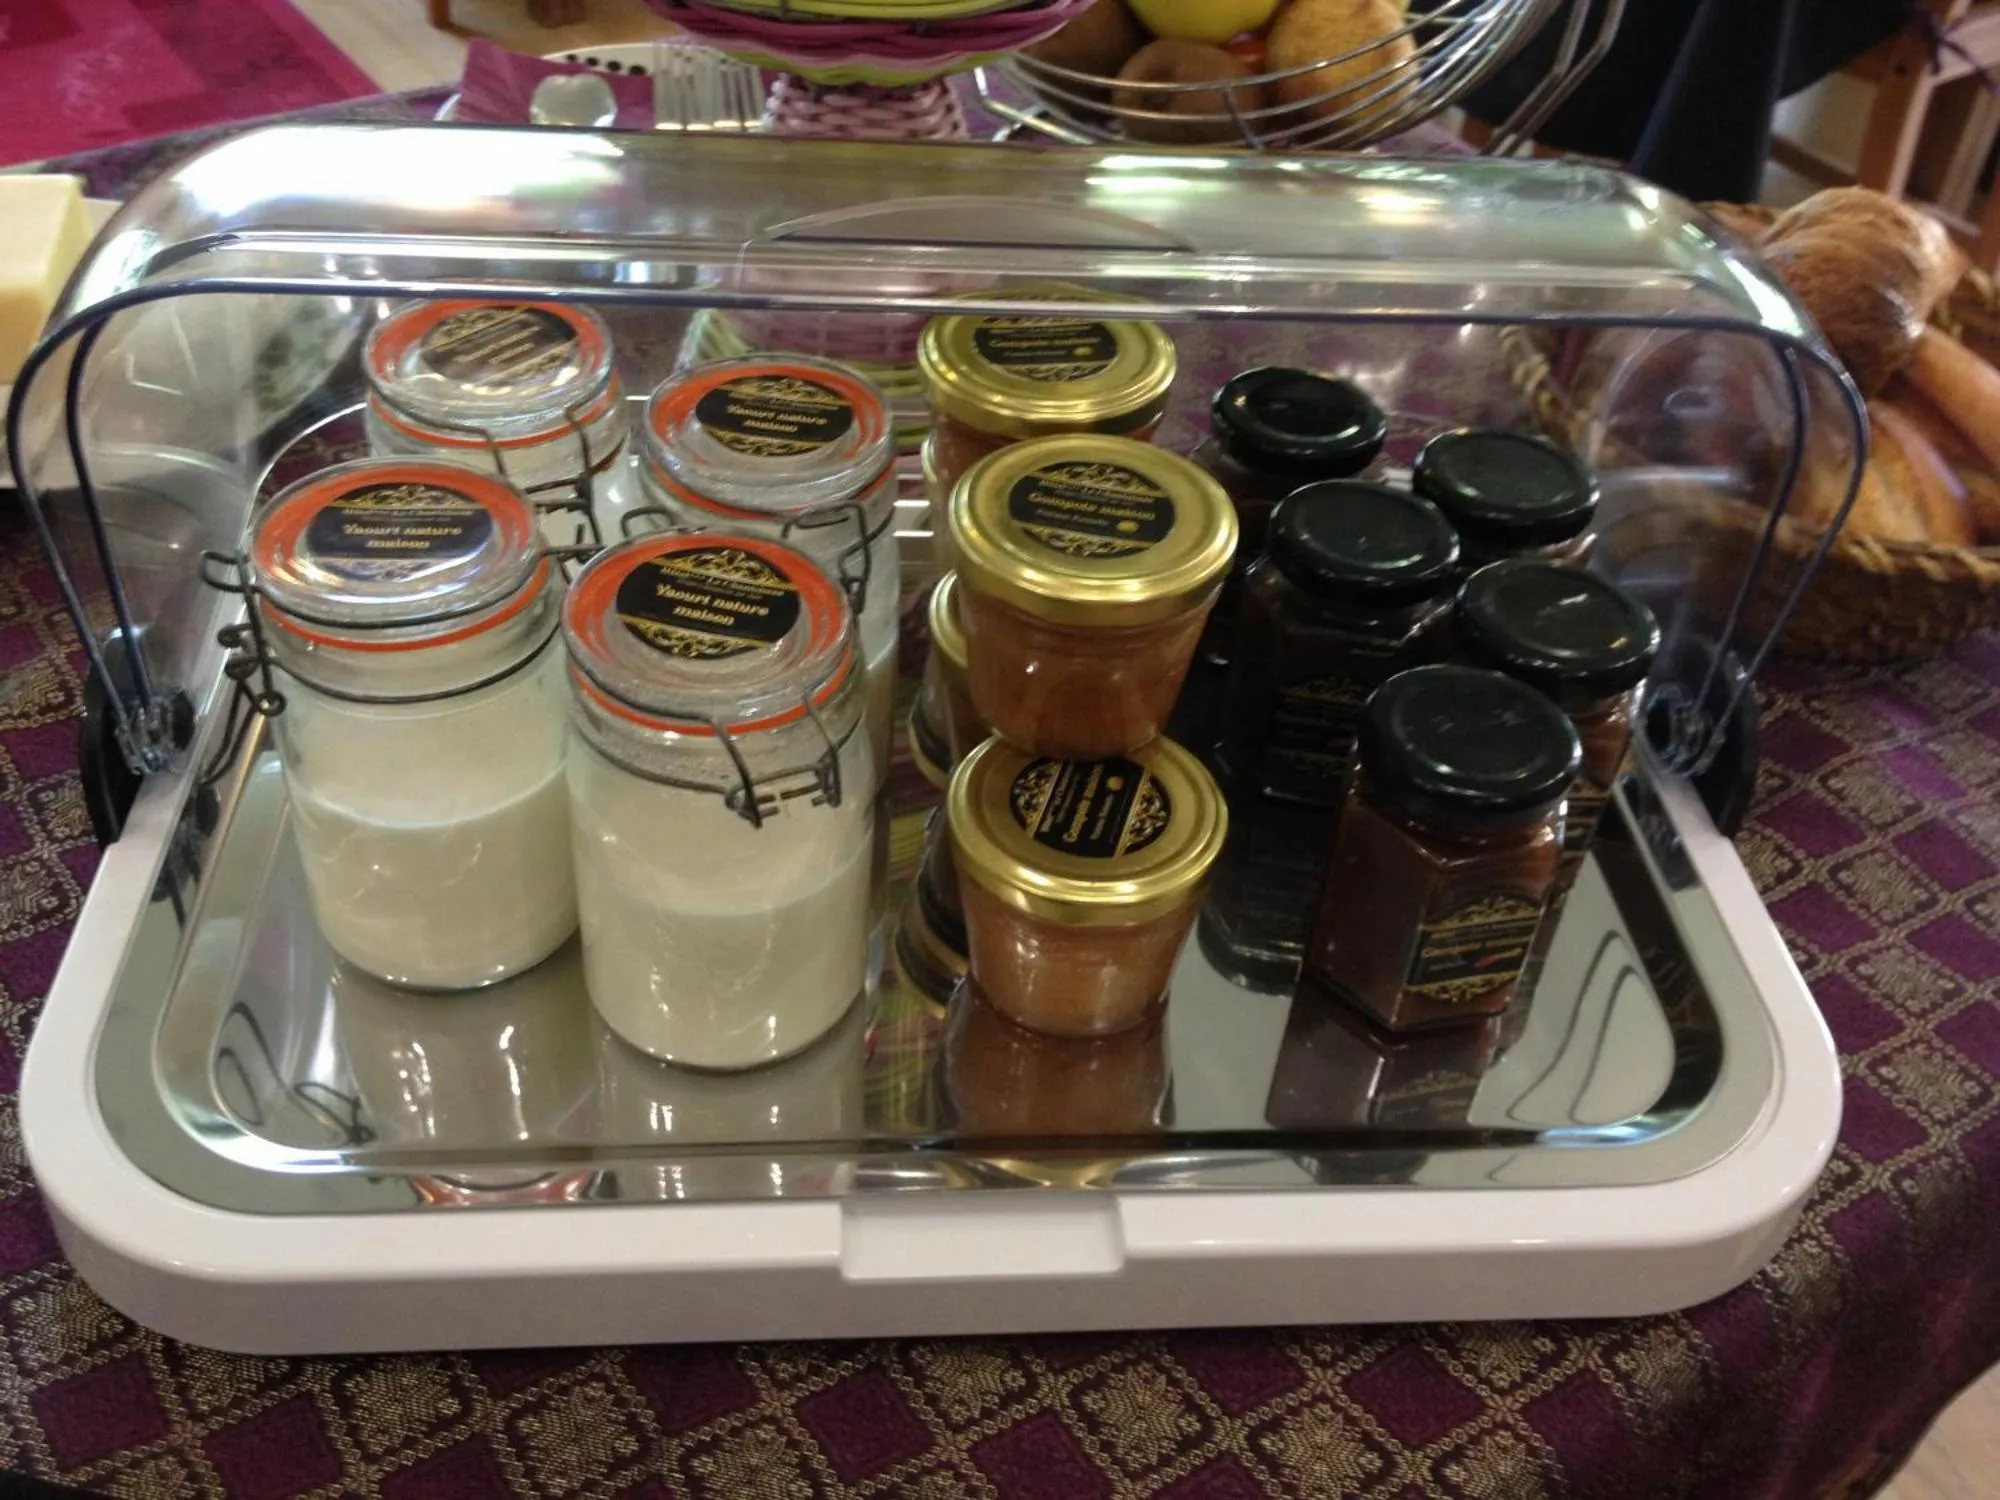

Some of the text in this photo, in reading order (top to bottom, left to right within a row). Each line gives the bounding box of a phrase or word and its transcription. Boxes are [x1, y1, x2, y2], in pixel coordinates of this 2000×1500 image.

[341, 522, 463, 537] Yaourt nature
[365, 537, 431, 550] maison
[656, 582, 712, 606] Yaourt
[712, 597, 770, 618] nature
[671, 604, 736, 627] maison
